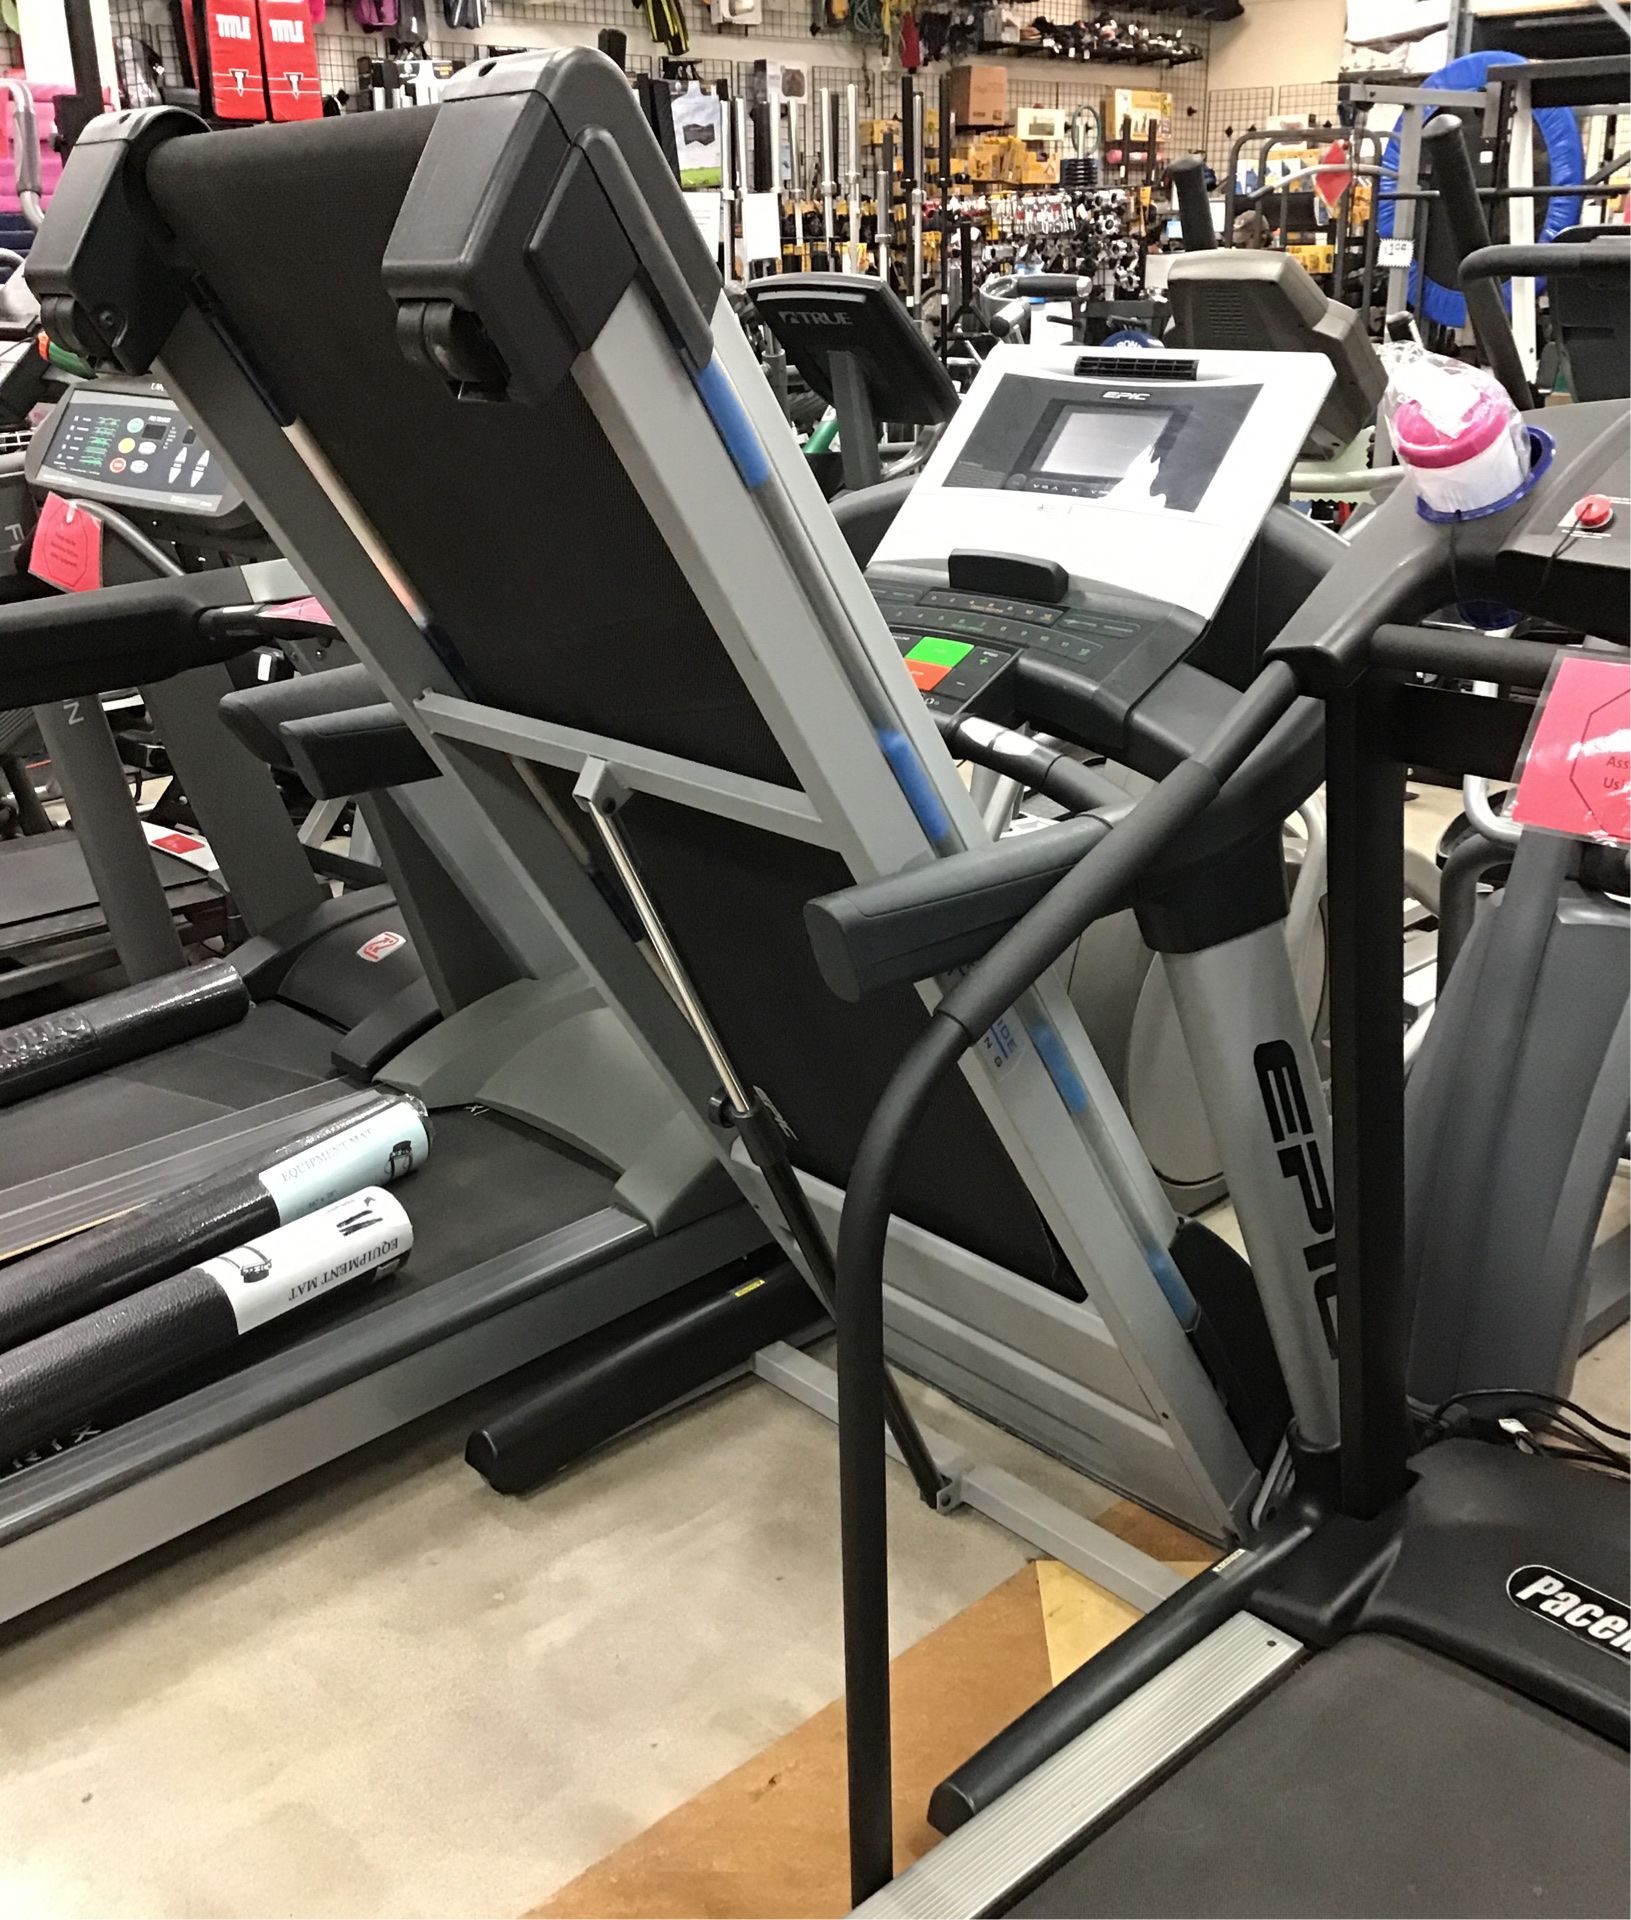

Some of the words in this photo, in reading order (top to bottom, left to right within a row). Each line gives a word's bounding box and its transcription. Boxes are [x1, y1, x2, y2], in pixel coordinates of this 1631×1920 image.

[796, 311, 854, 325] TRUE
[1102, 391, 1151, 401] EPIC
[281, 1142, 348, 1182] EQUIPMENT
[350, 1127, 376, 1146] MAT
[321, 1237, 399, 1285] EQUIPMENT
[288, 1279, 319, 1301] MAT
